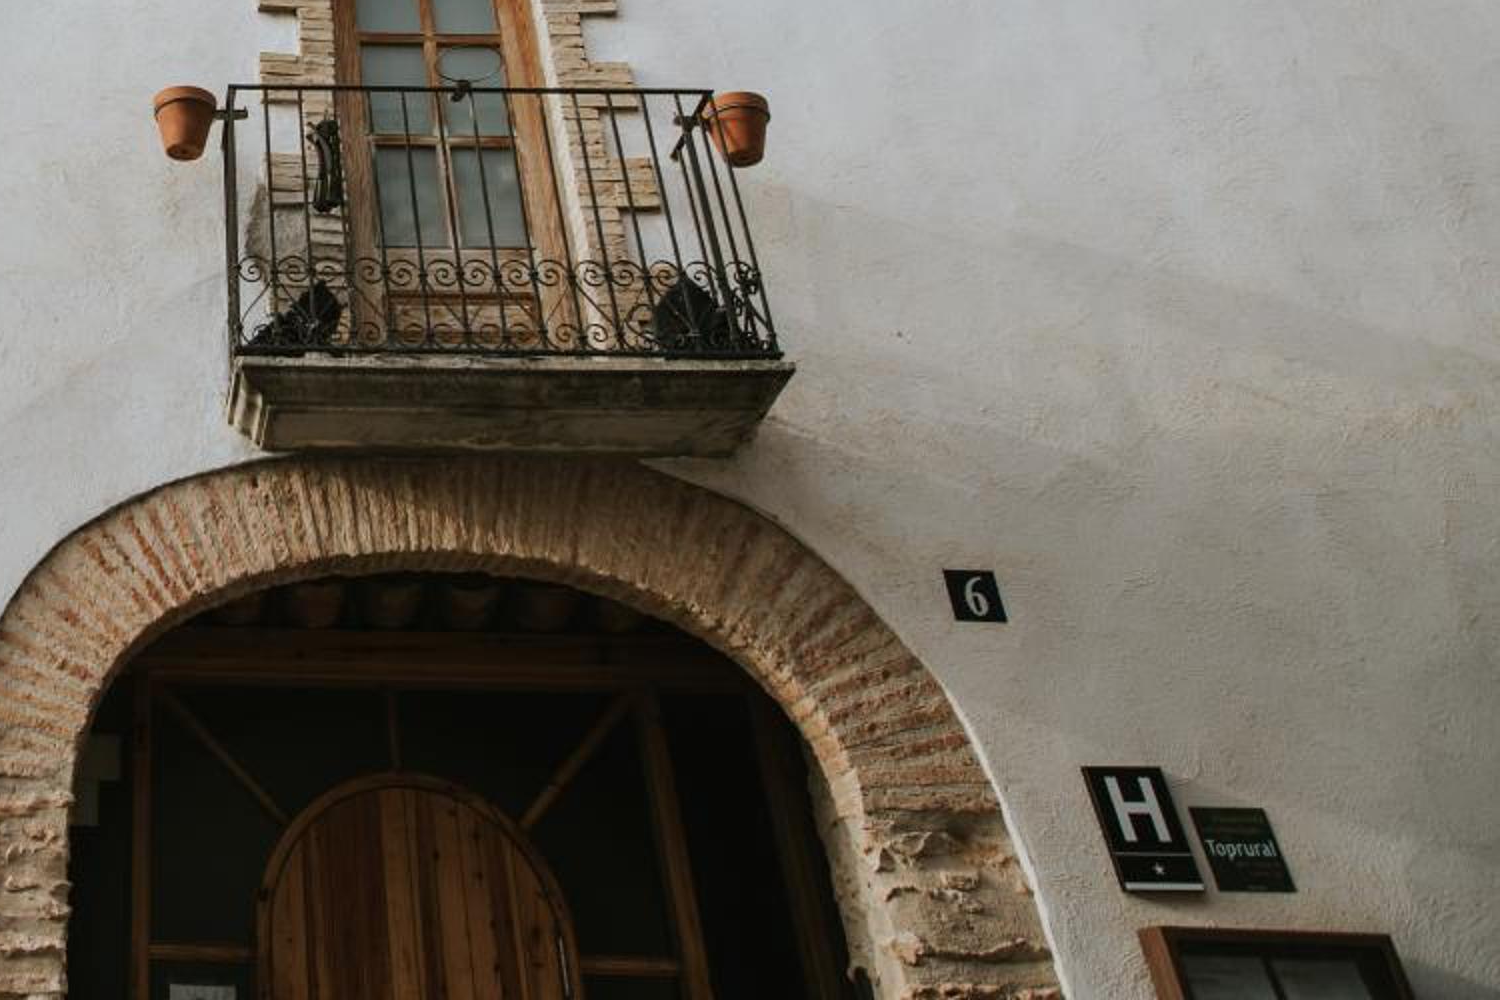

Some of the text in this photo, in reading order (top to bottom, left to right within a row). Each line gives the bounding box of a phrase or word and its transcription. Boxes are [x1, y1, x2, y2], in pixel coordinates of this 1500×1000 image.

[964, 576, 990, 617] 6
[1103, 775, 1173, 844] H
[1204, 838, 1278, 861] Toprural
